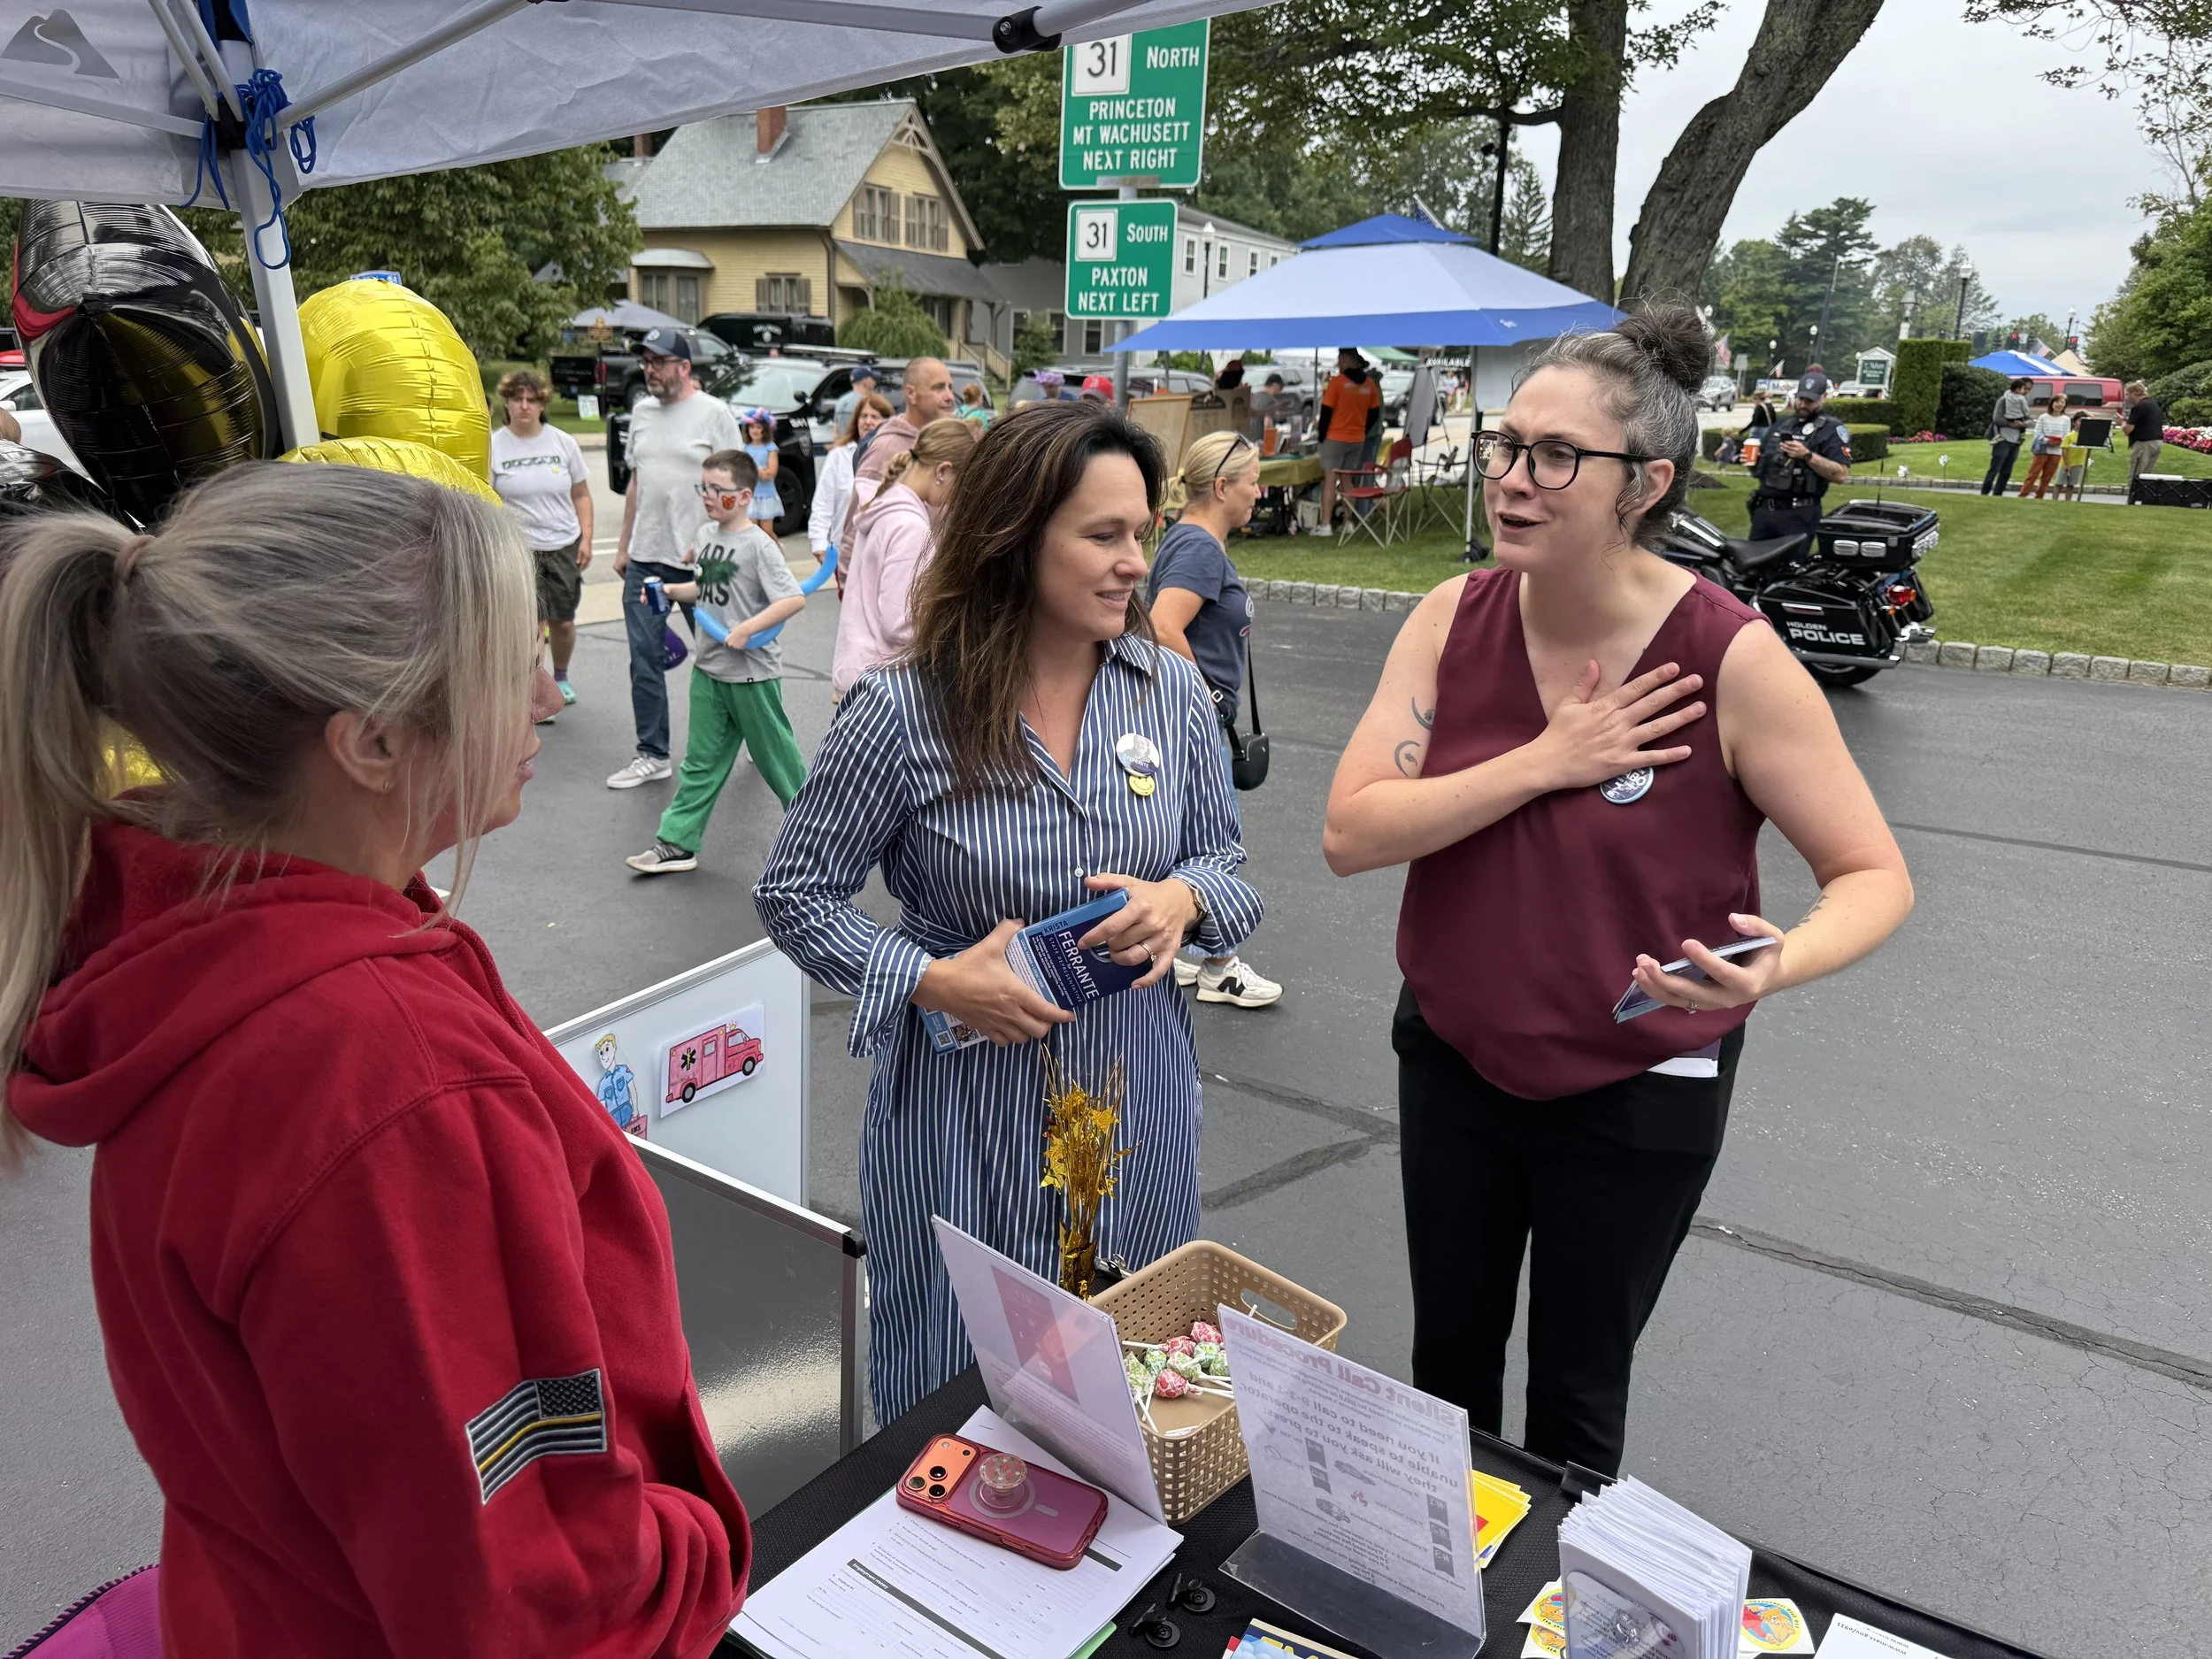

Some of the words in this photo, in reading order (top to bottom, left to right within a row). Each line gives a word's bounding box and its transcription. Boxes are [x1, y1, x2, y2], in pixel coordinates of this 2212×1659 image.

[1087, 41, 1117, 78] 31
[1146, 46, 1200, 69] NORTH
[1089, 97, 1176, 120] PRINCETON
[1072, 126, 1094, 145] MT
[1099, 121, 1191, 145] WACHUSETT
[1083, 150, 1123, 171] NEXT
[1130, 148, 1178, 170] RIGHT
[1086, 222, 1107, 249] 31
[1126, 221, 1169, 243] SOUTH
[1091, 267, 1148, 288] PAXTON
[1078, 292, 1117, 311] NEXT
[1122, 292, 1160, 312] LEFT
[1786, 621, 1828, 631] HOLDEN
[1789, 628, 1865, 645] POLICE
[1044, 920, 1069, 933] KRISTA
[1048, 937, 1060, 954] STATE
[1057, 956, 1083, 1002] REPRESENTATIVE
[1058, 931, 1100, 1000] FERRANTE
